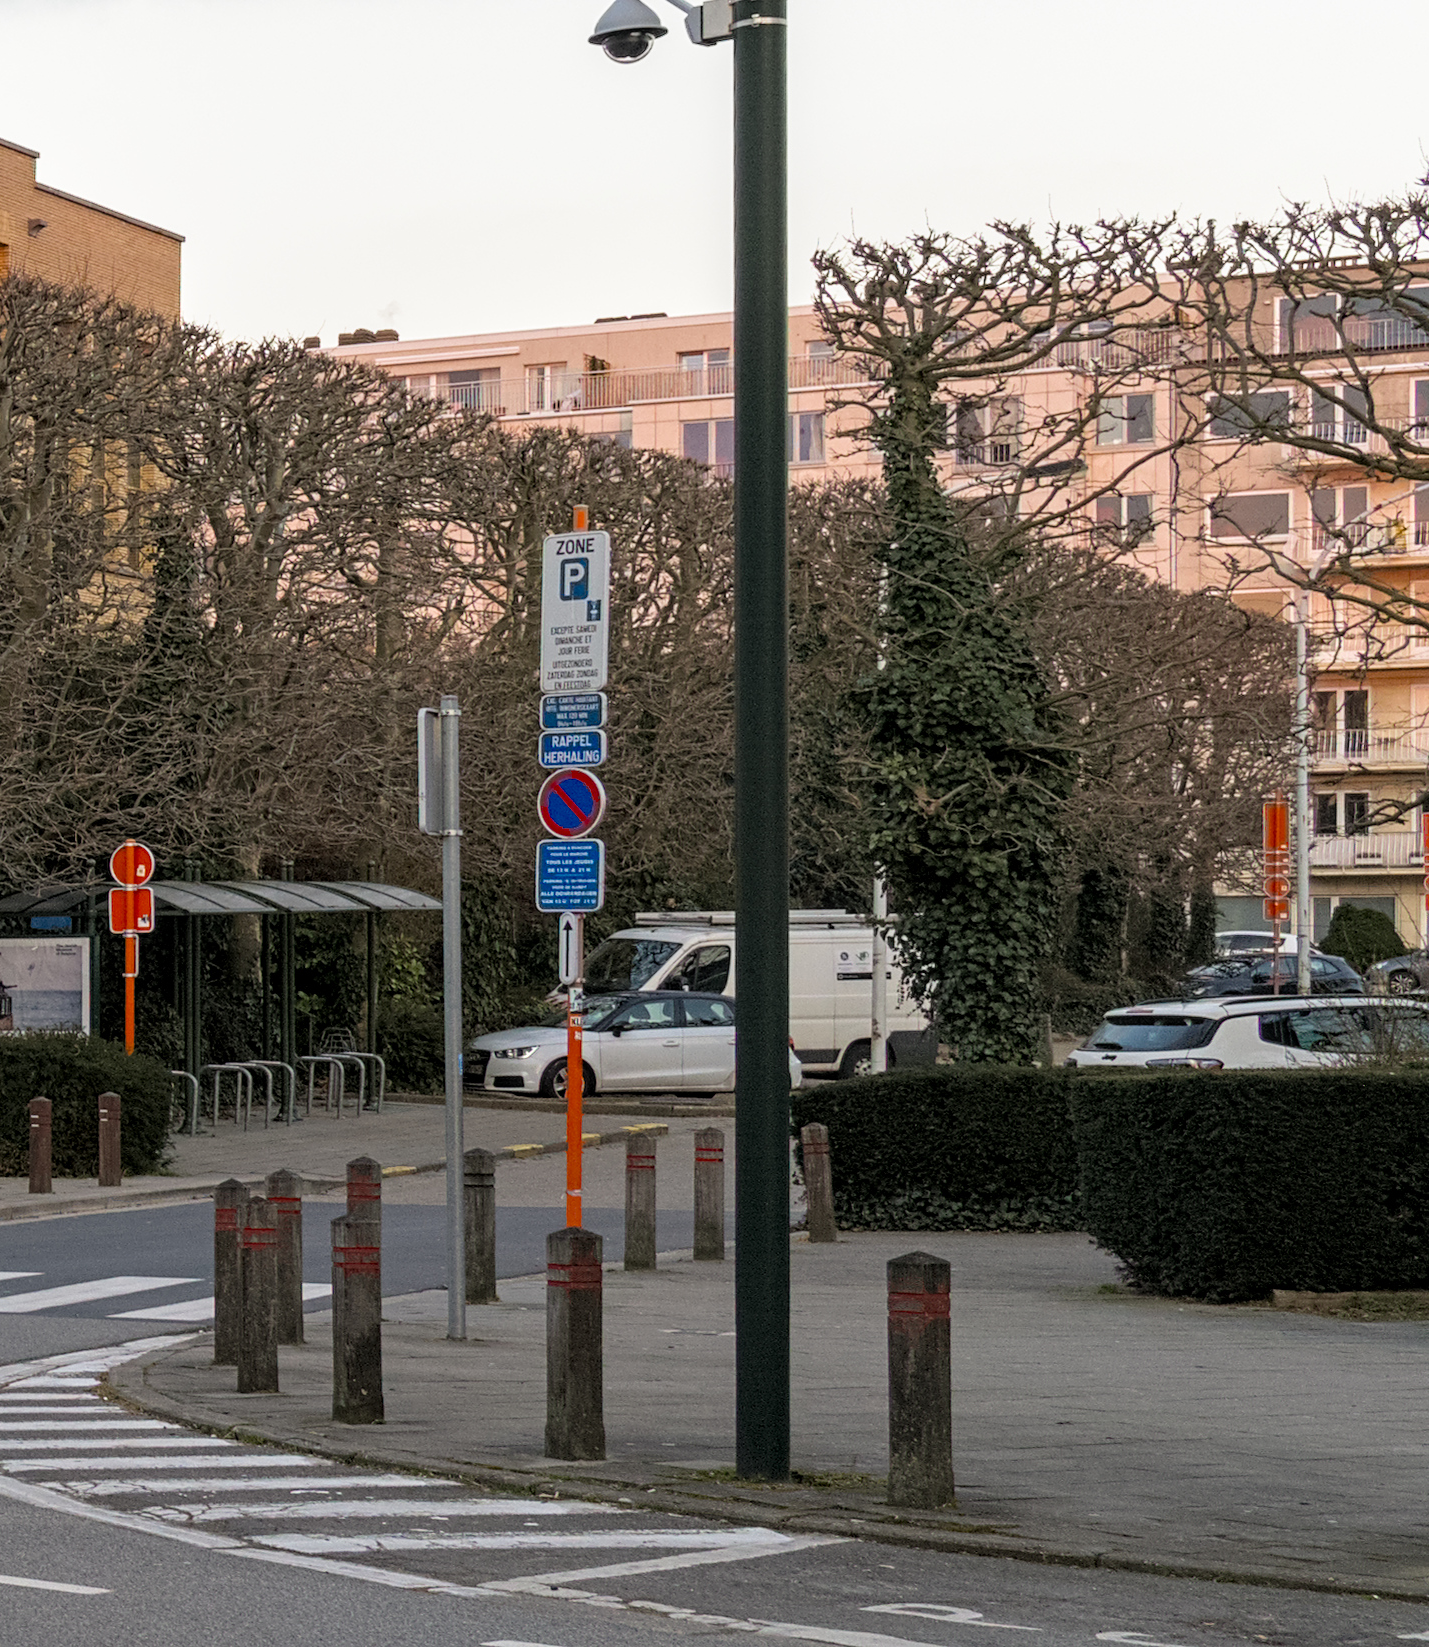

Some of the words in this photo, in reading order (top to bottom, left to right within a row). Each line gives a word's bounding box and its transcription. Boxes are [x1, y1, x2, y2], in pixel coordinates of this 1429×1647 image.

[556, 538, 595, 555] ZONE
[564, 562, 585, 596] P
[585, 635, 592, 643] ET
[552, 734, 593, 748] RAPPEL
[543, 749, 600, 764] HERHALING
